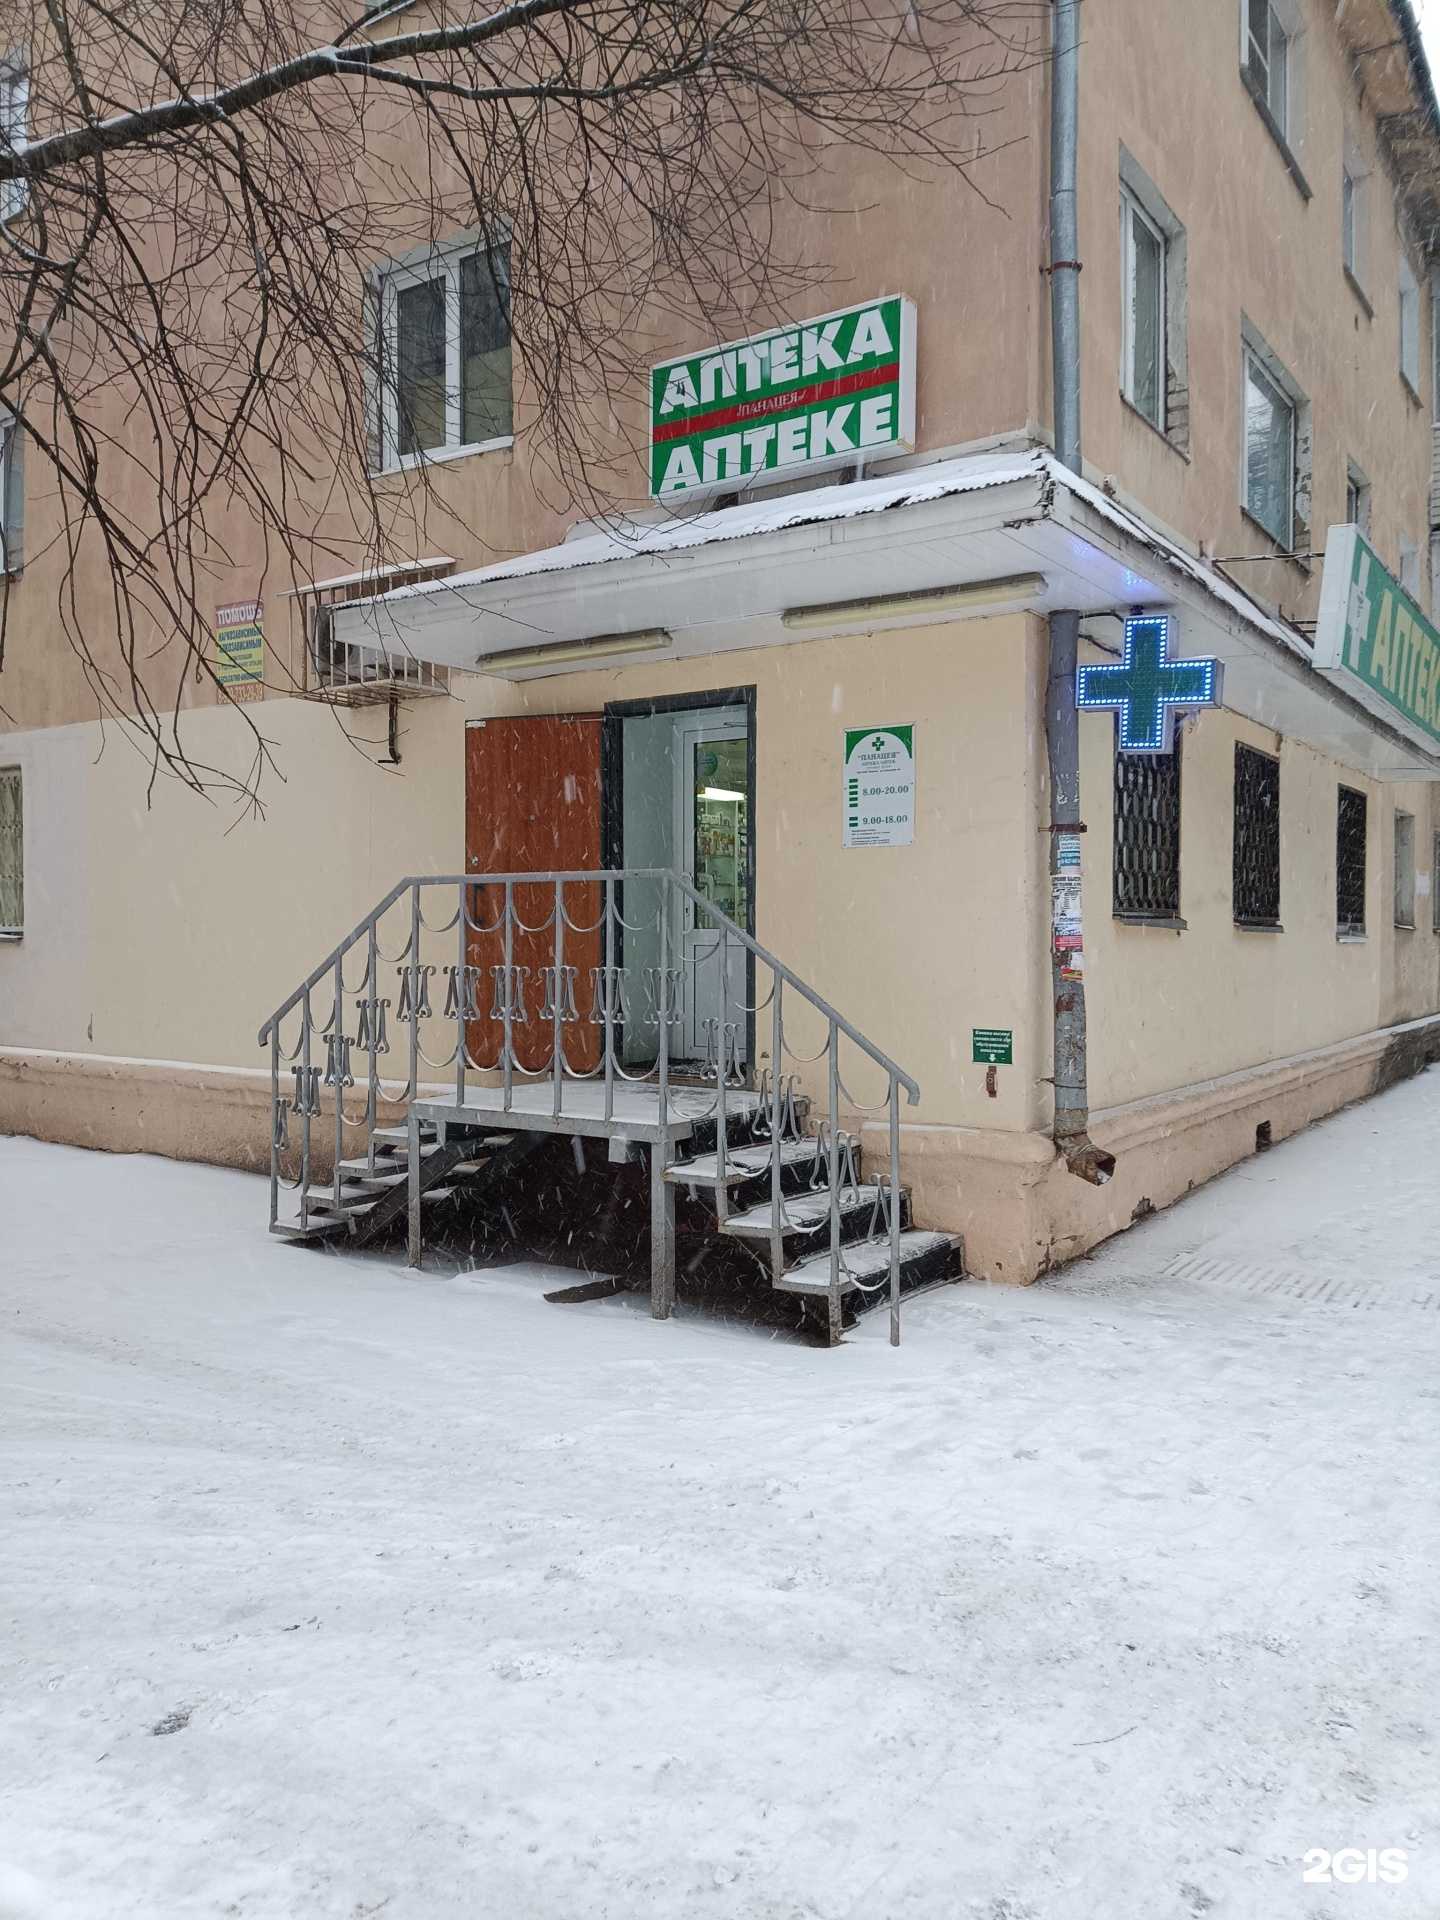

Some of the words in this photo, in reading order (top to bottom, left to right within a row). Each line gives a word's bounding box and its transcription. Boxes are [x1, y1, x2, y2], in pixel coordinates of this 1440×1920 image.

[659, 308, 894, 414] АПТЕКА
[659, 393, 893, 494] АПТЕКЕ
[862, 785, 909, 796] 8.00-20.00
[862, 815, 908, 825] 9.00-18.00
